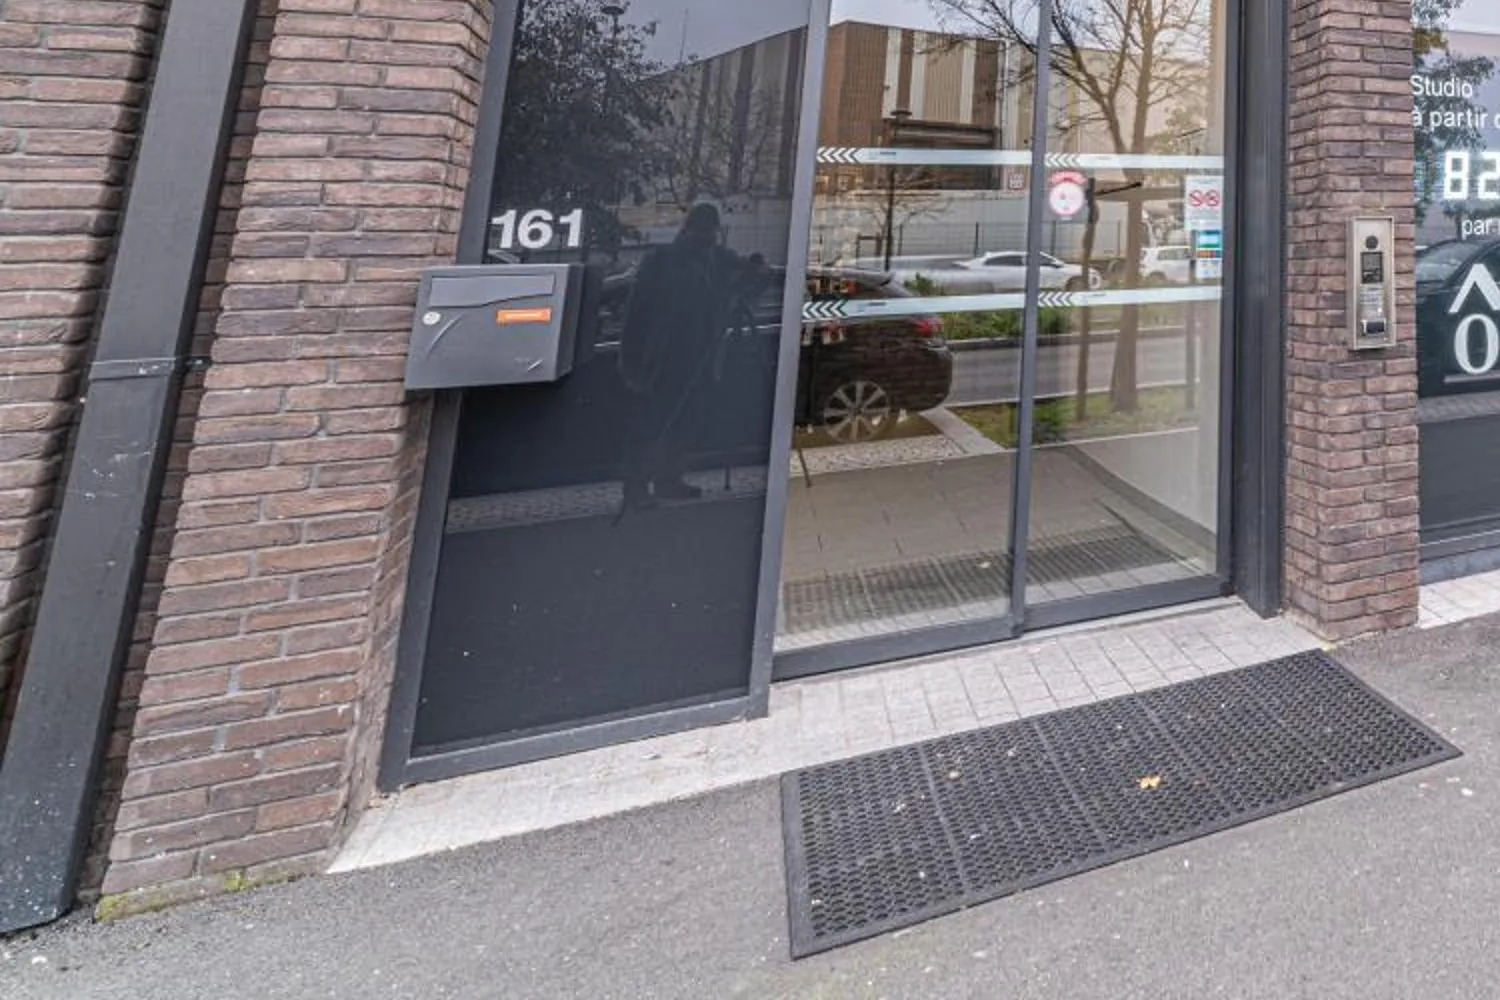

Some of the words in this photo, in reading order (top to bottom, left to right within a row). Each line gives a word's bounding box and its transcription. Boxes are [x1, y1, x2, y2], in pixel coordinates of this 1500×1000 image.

[1410, 75, 1473, 99] Studio
[1430, 109, 1488, 131] partir
[491, 208, 583, 249] 161
[1461, 217, 1494, 240] par
